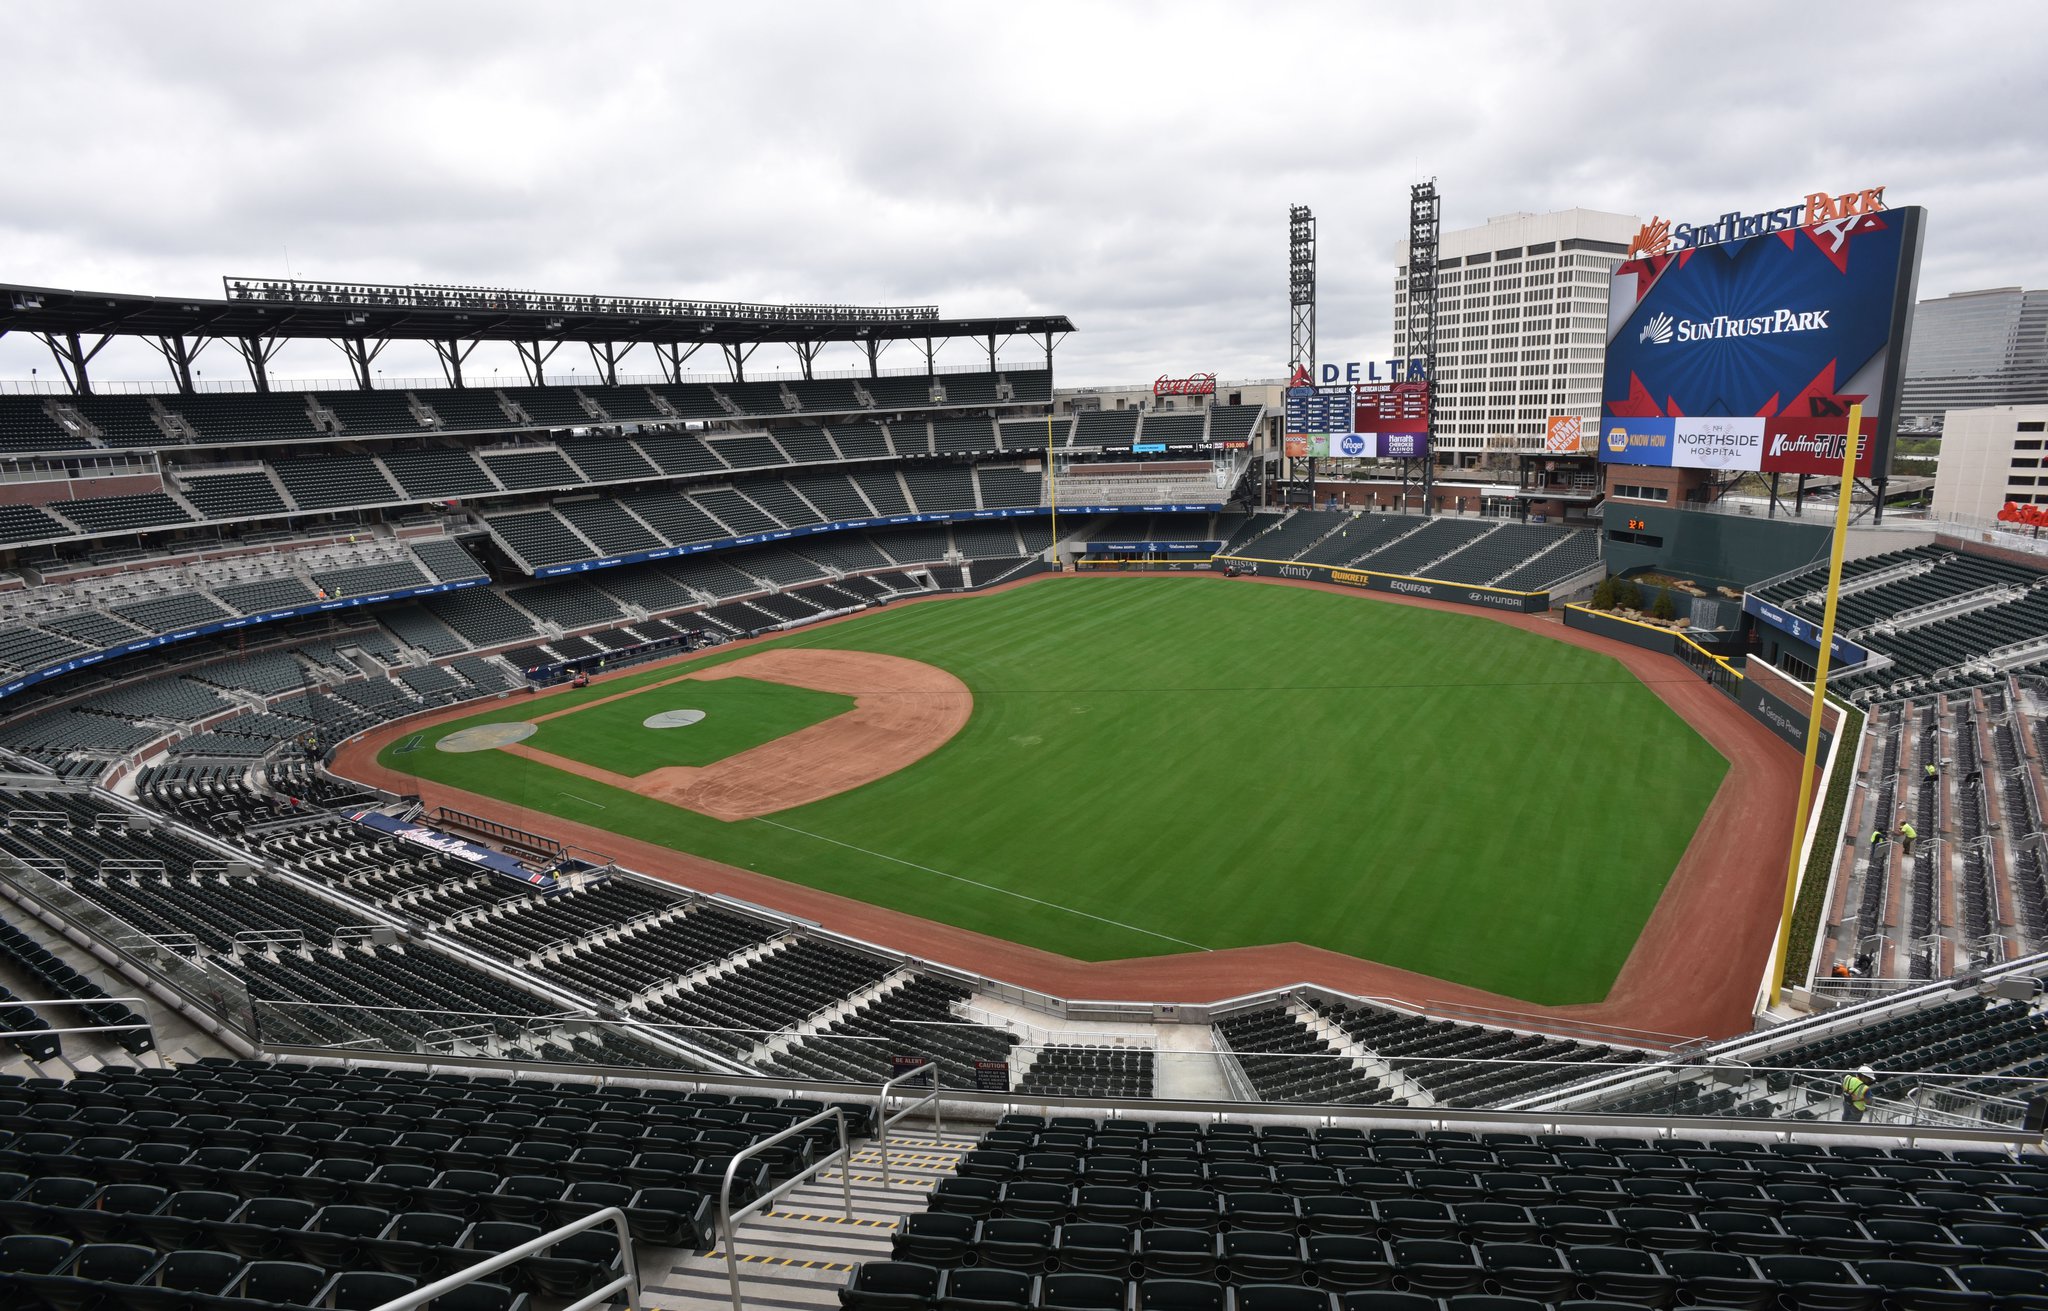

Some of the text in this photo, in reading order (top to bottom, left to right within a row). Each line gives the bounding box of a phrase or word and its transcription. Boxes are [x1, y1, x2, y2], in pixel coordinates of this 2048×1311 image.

[1322, 358, 1426, 383] DELTA
[1547, 416, 1581, 450] HOME
[1551, 419, 1566, 434] THE
[1343, 437, 1364, 453] Kroger
[1610, 433, 1625, 446] NAPA
[1630, 434, 1666, 447] KNOW HOW
[1678, 433, 1759, 447] NORTHSIDE
[1769, 433, 1830, 457] Kauffman
[1690, 447, 1742, 457] HOSPITAL
[1224, 559, 1257, 569] WELLSTAR
[1279, 564, 1313, 580] xfinity
[1331, 570, 1369, 583] QUIKRETE
[1389, 580, 1433, 594] EQUIFAX
[1484, 594, 1522, 607] HYUNDAI
[1766, 706, 1802, 739] Georgia Power
